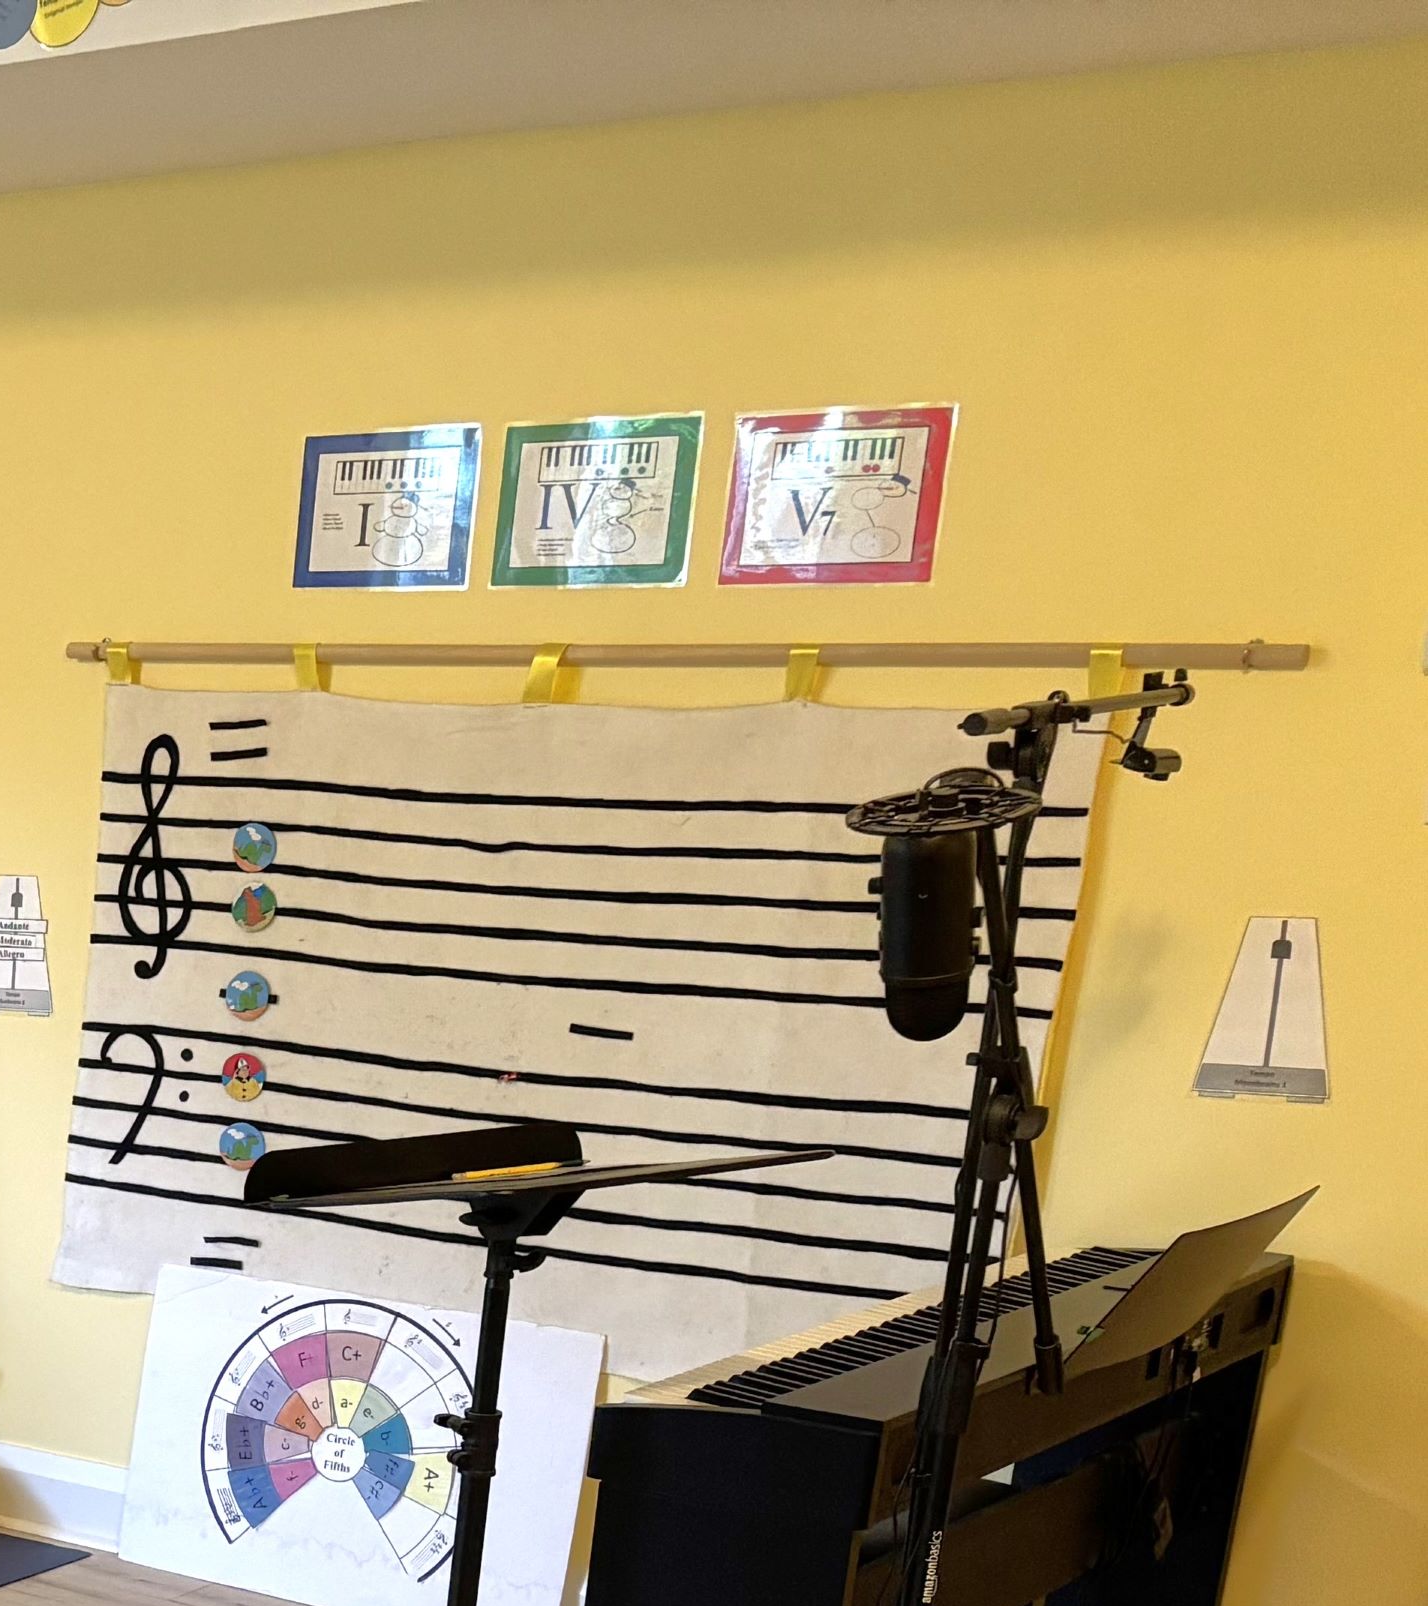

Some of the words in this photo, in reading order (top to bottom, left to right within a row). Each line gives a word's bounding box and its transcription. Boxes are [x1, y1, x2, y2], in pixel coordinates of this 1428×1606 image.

[535, 482, 605, 531] IV
[354, 502, 376, 548] I
[297, 1351, 314, 1369] F+
[341, 1345, 362, 1362] C+
[326, 1433, 356, 1447] Circle
[334, 1449, 344, 1458] of
[323, 1459, 351, 1474] Fifths
[423, 1466, 440, 1492] A+
[922, 1530, 943, 1604] amazonbasics
